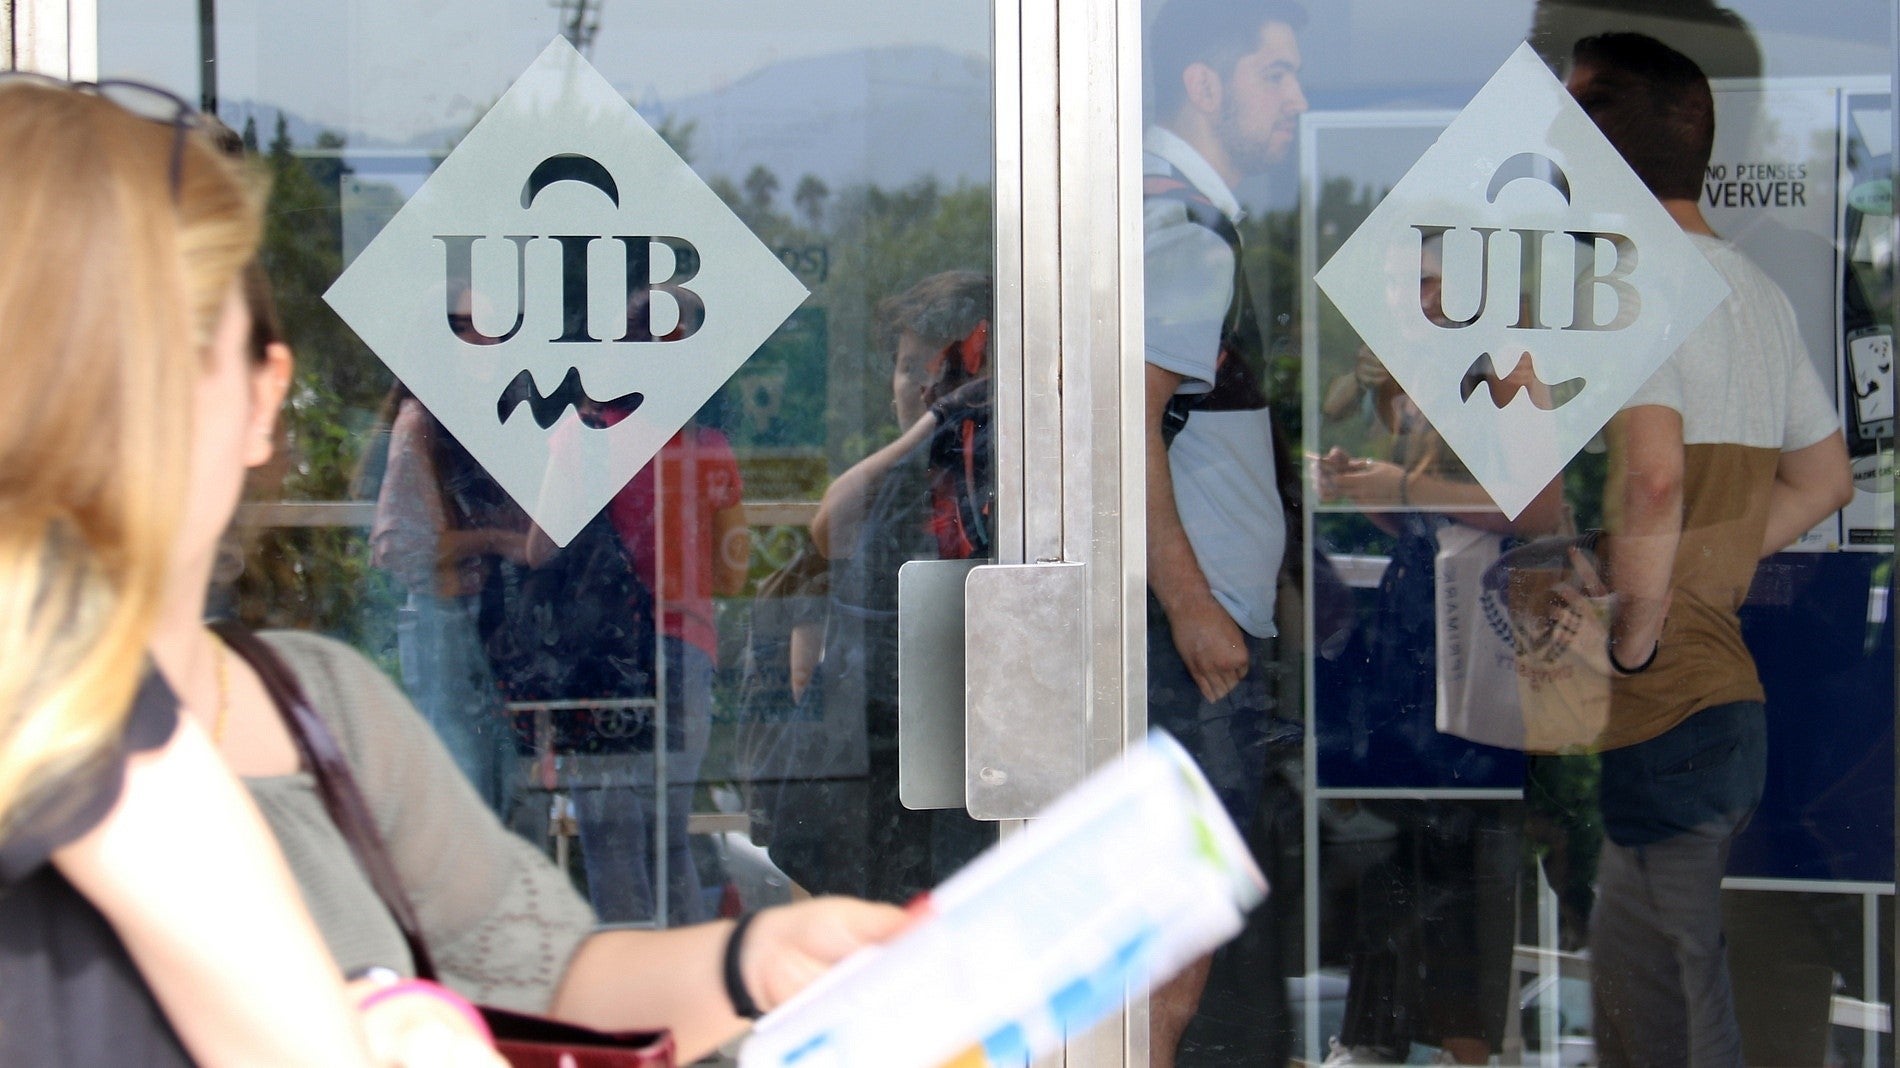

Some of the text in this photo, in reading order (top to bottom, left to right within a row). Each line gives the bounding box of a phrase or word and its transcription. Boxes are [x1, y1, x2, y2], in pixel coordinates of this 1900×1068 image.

[1705, 164, 1807, 181] NO PIENSES
[1705, 182, 1807, 208] VERVER
[433, 235, 706, 346] UIB
[1410, 224, 1641, 331] UIB
